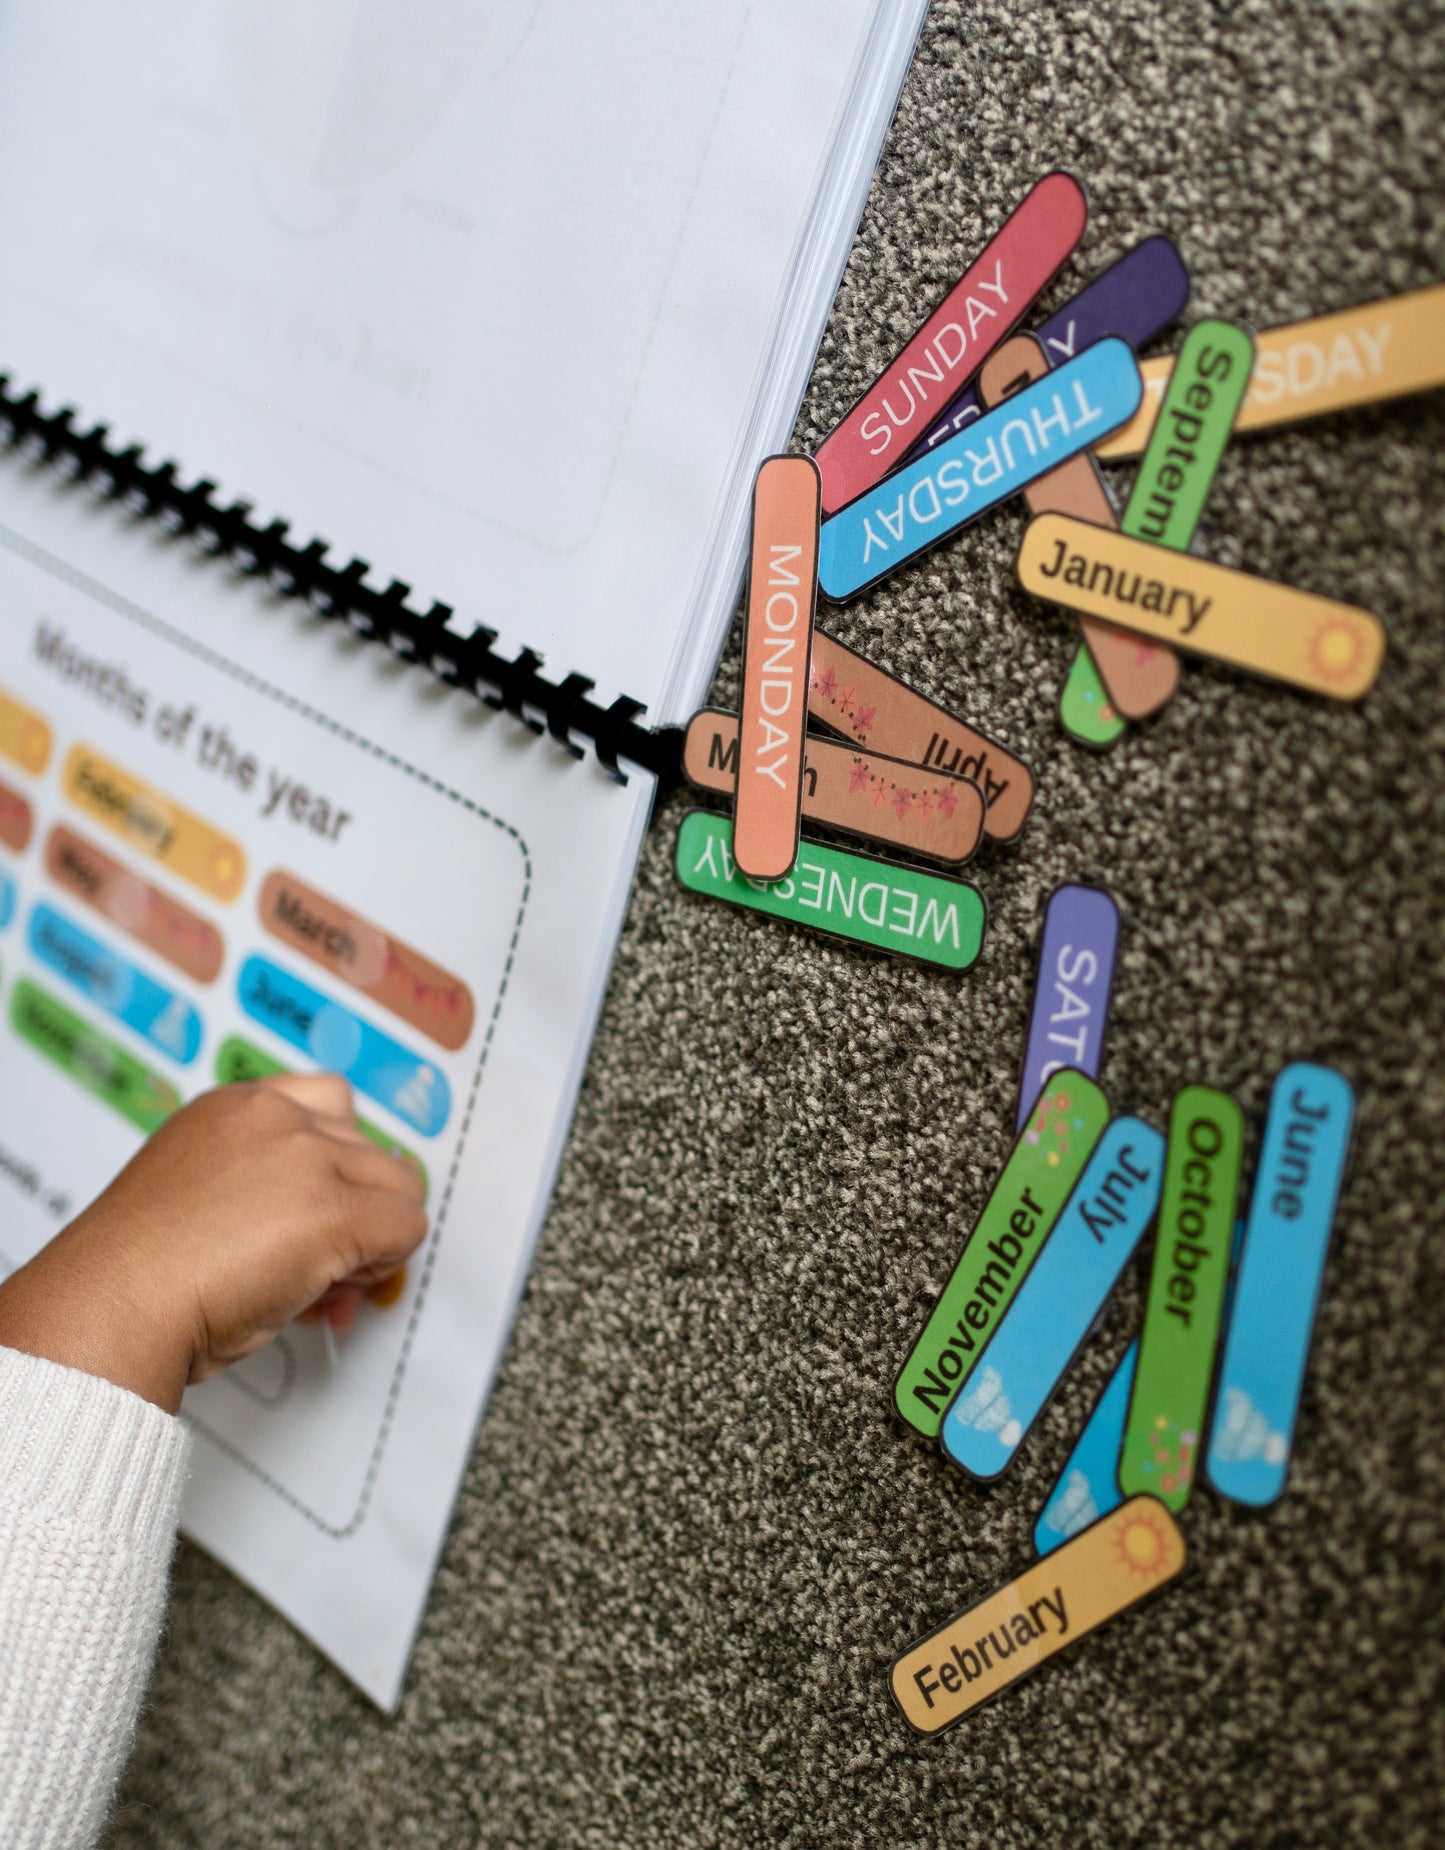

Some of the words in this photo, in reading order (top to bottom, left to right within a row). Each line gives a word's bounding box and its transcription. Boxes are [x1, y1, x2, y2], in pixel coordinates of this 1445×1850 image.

[860, 260, 1009, 457] SUNDAY
[1138, 345, 1233, 539] Septem
[861, 379, 1103, 565] THURSDAY
[754, 544, 802, 790] MONDAY
[1040, 538, 1212, 633] January
[34, 616, 148, 728] Months
[154, 702, 197, 746] of
[198, 723, 259, 793] the
[261, 767, 352, 843] year
[1079, 1143, 1151, 1246] July
[1165, 1114, 1223, 1328] October
[1272, 1087, 1329, 1222] June
[911, 1187, 1048, 1415] November
[912, 1588, 1068, 1709] February
